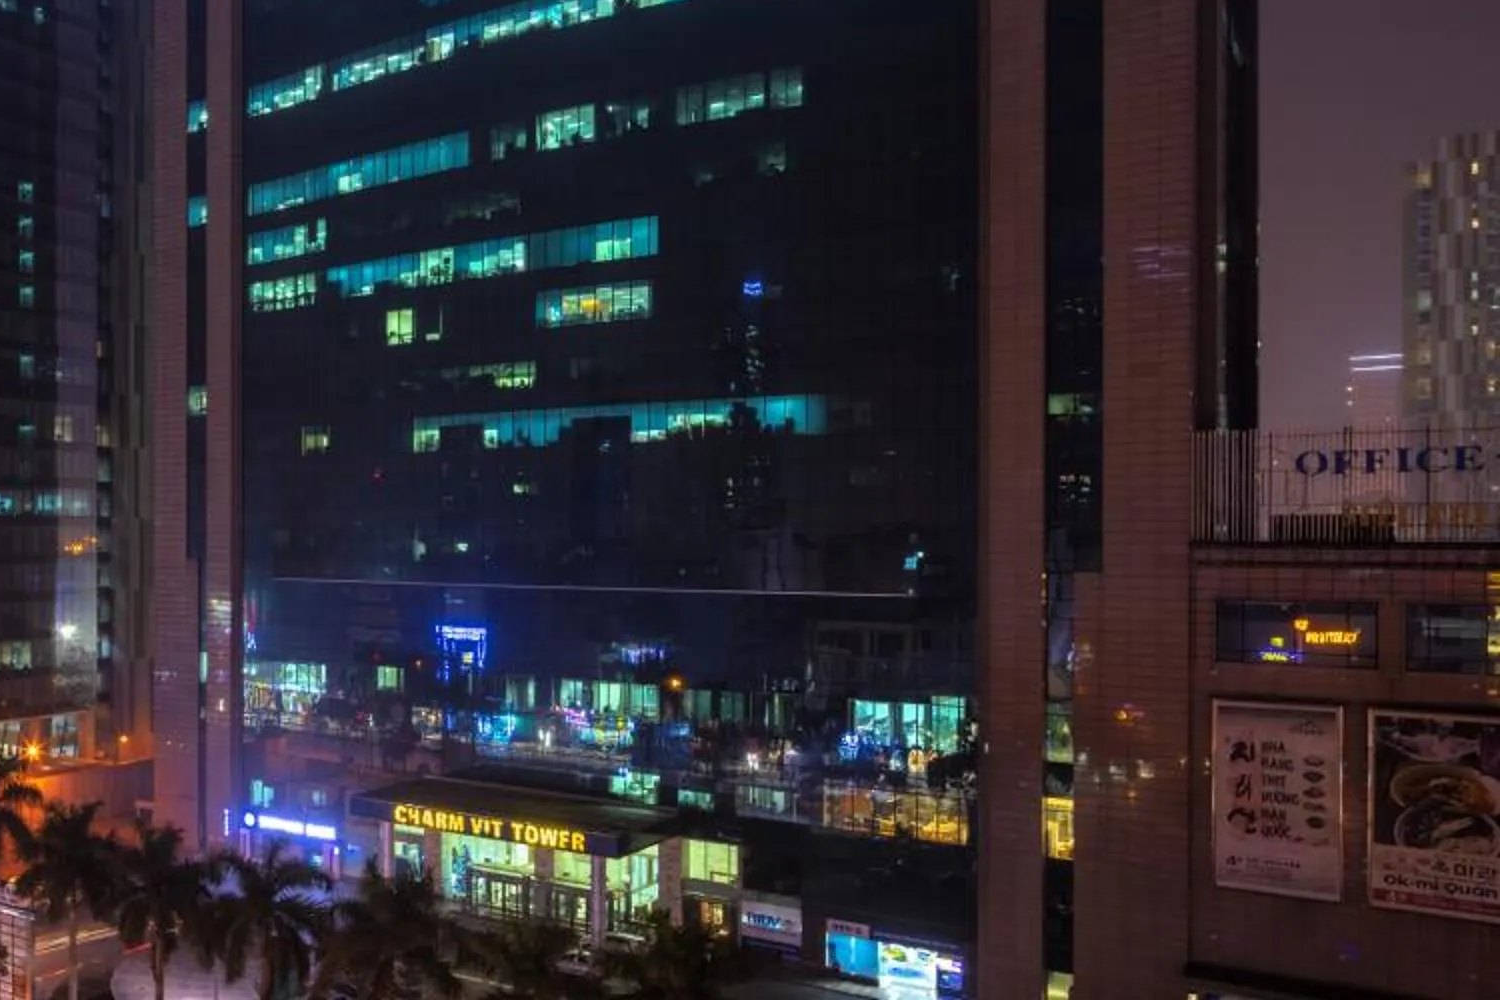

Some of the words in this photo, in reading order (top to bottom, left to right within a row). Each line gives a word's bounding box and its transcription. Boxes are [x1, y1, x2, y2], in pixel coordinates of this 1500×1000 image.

[1295, 445, 1486, 477] OFFICE
[394, 804, 465, 833] CHARM
[470, 816, 504, 838] VIT
[511, 822, 586, 851] TOWER
